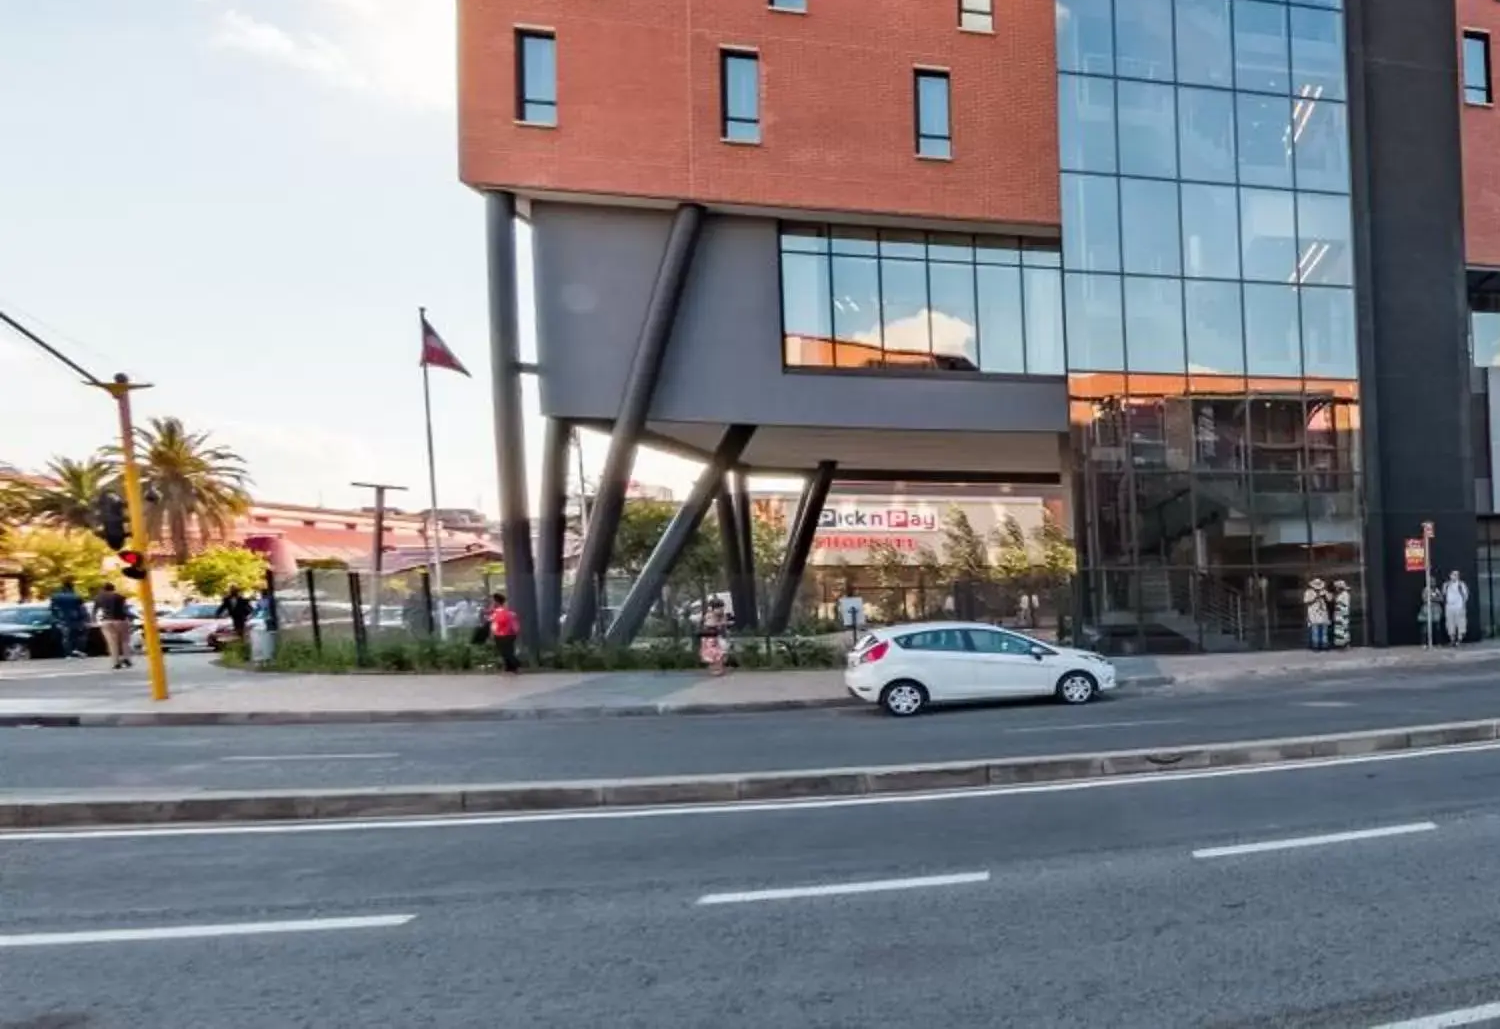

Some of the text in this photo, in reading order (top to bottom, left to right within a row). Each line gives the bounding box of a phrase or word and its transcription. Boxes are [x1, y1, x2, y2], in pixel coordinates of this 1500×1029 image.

[820, 509, 935, 529] Pick n Pay
